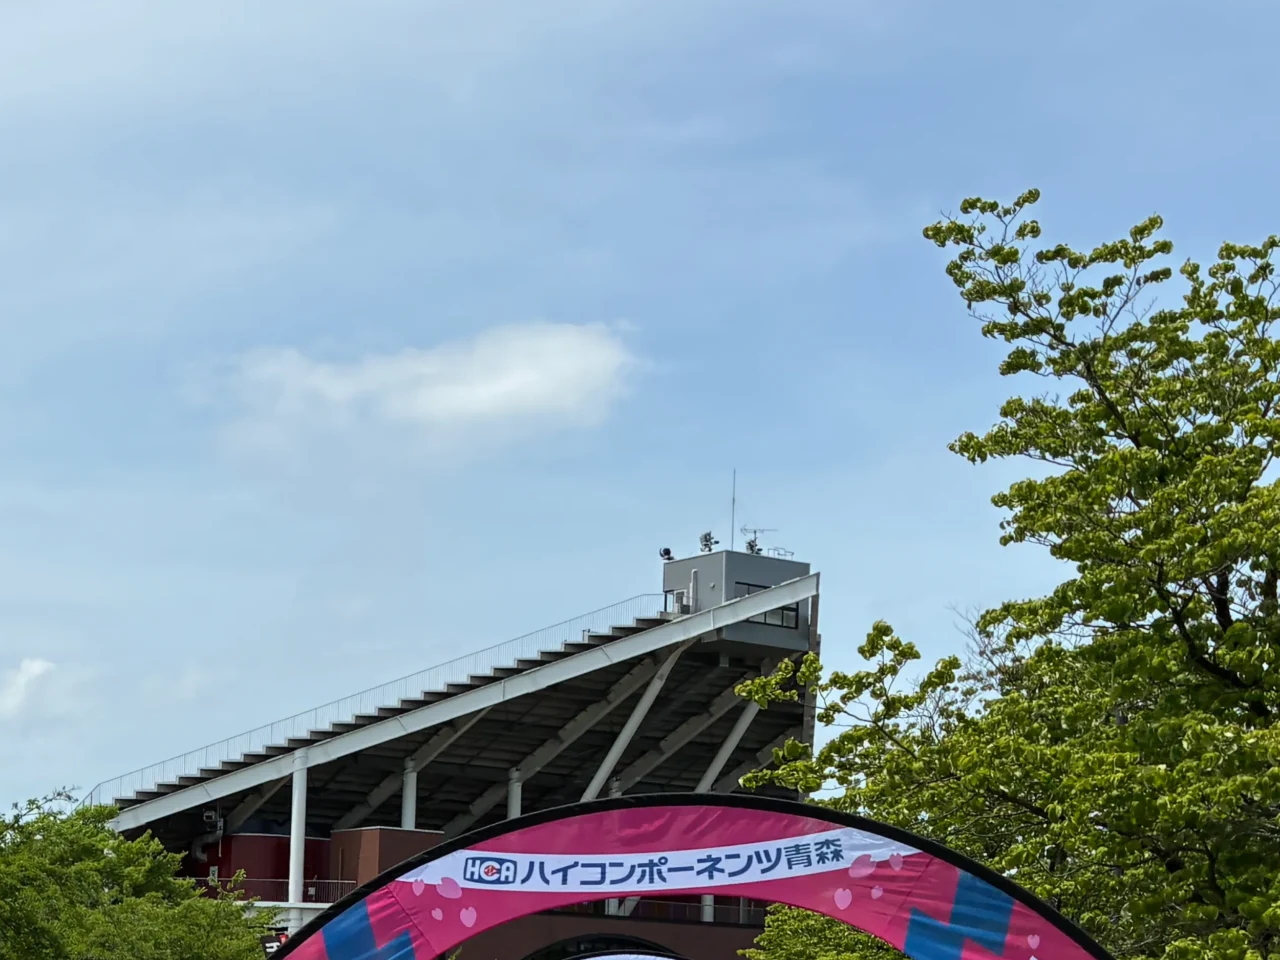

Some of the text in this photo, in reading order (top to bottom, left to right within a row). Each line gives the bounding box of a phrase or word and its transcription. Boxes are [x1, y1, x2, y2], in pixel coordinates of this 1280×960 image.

[465, 837, 845, 886] HCA ハイコンポーネンツ青森
